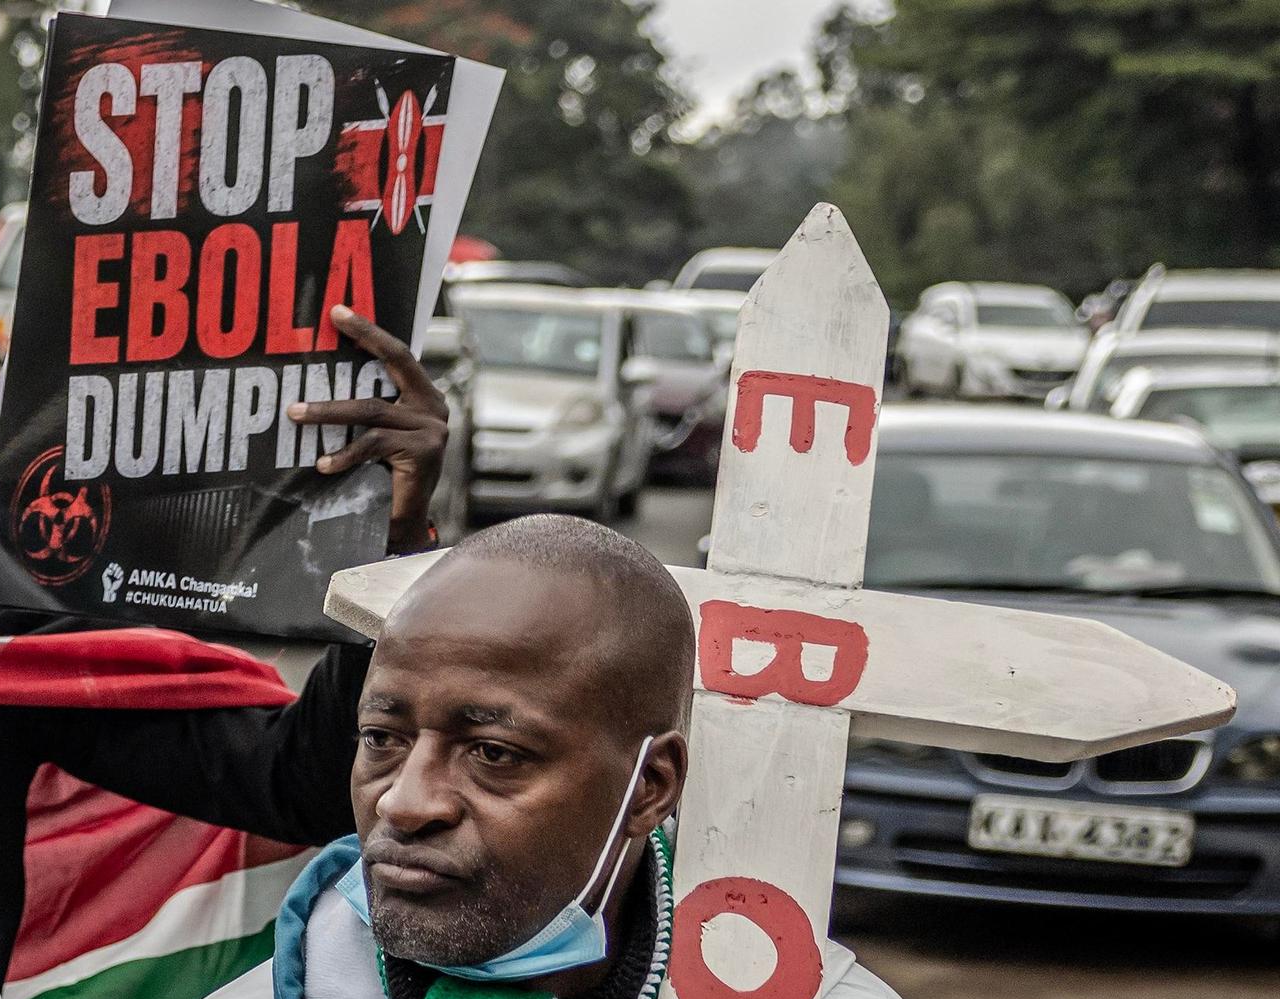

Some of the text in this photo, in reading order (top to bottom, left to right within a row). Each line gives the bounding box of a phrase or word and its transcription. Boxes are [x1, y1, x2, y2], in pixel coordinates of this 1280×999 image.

[68, 54, 336, 225] STOP
[69, 219, 378, 365] EBOLA
[125, 591, 228, 613] #CHUKUAHATUA
[128, 569, 177, 589] AMKA
